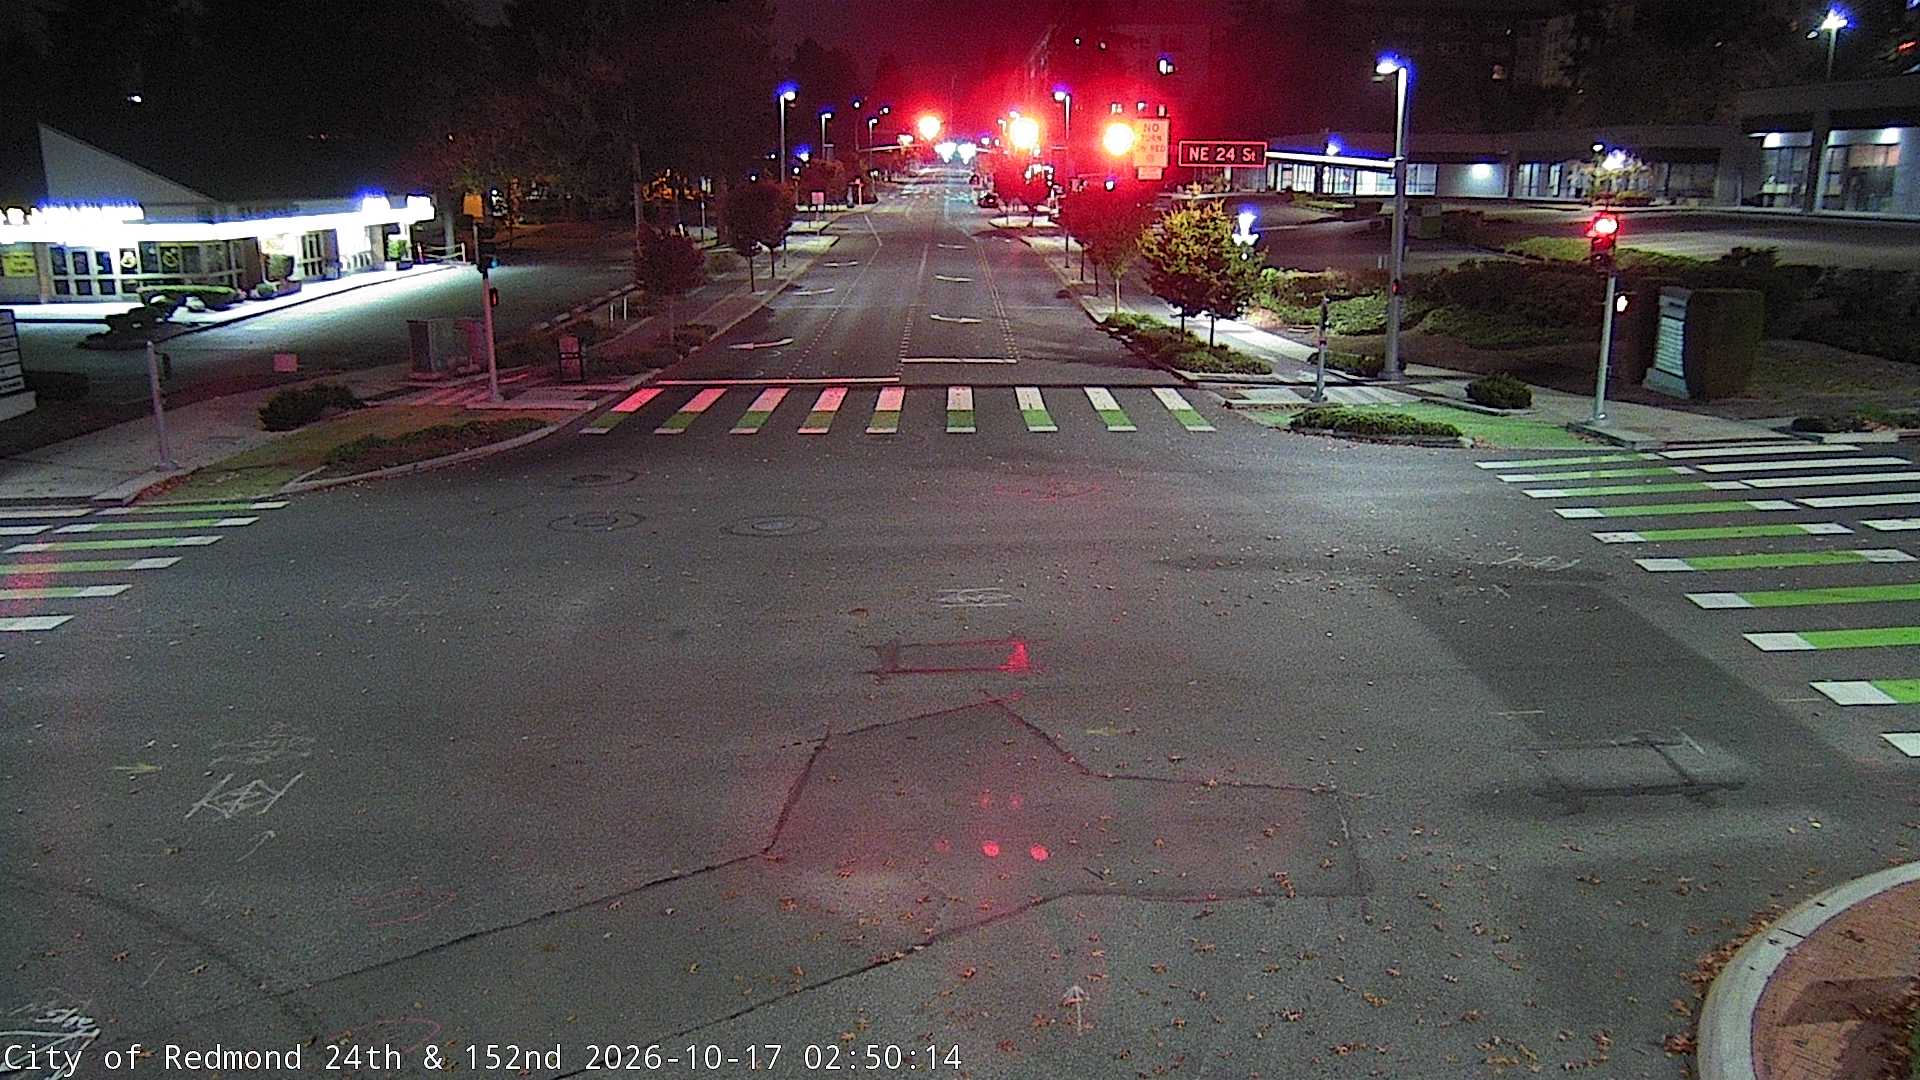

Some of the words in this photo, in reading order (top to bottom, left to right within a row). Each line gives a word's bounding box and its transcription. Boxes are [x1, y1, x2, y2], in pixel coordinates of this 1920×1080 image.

[1143, 123, 1160, 133] NO
[1189, 146, 1209, 162] NE
[1215, 147, 1236, 162] 24
[1242, 147, 1256, 162] St
